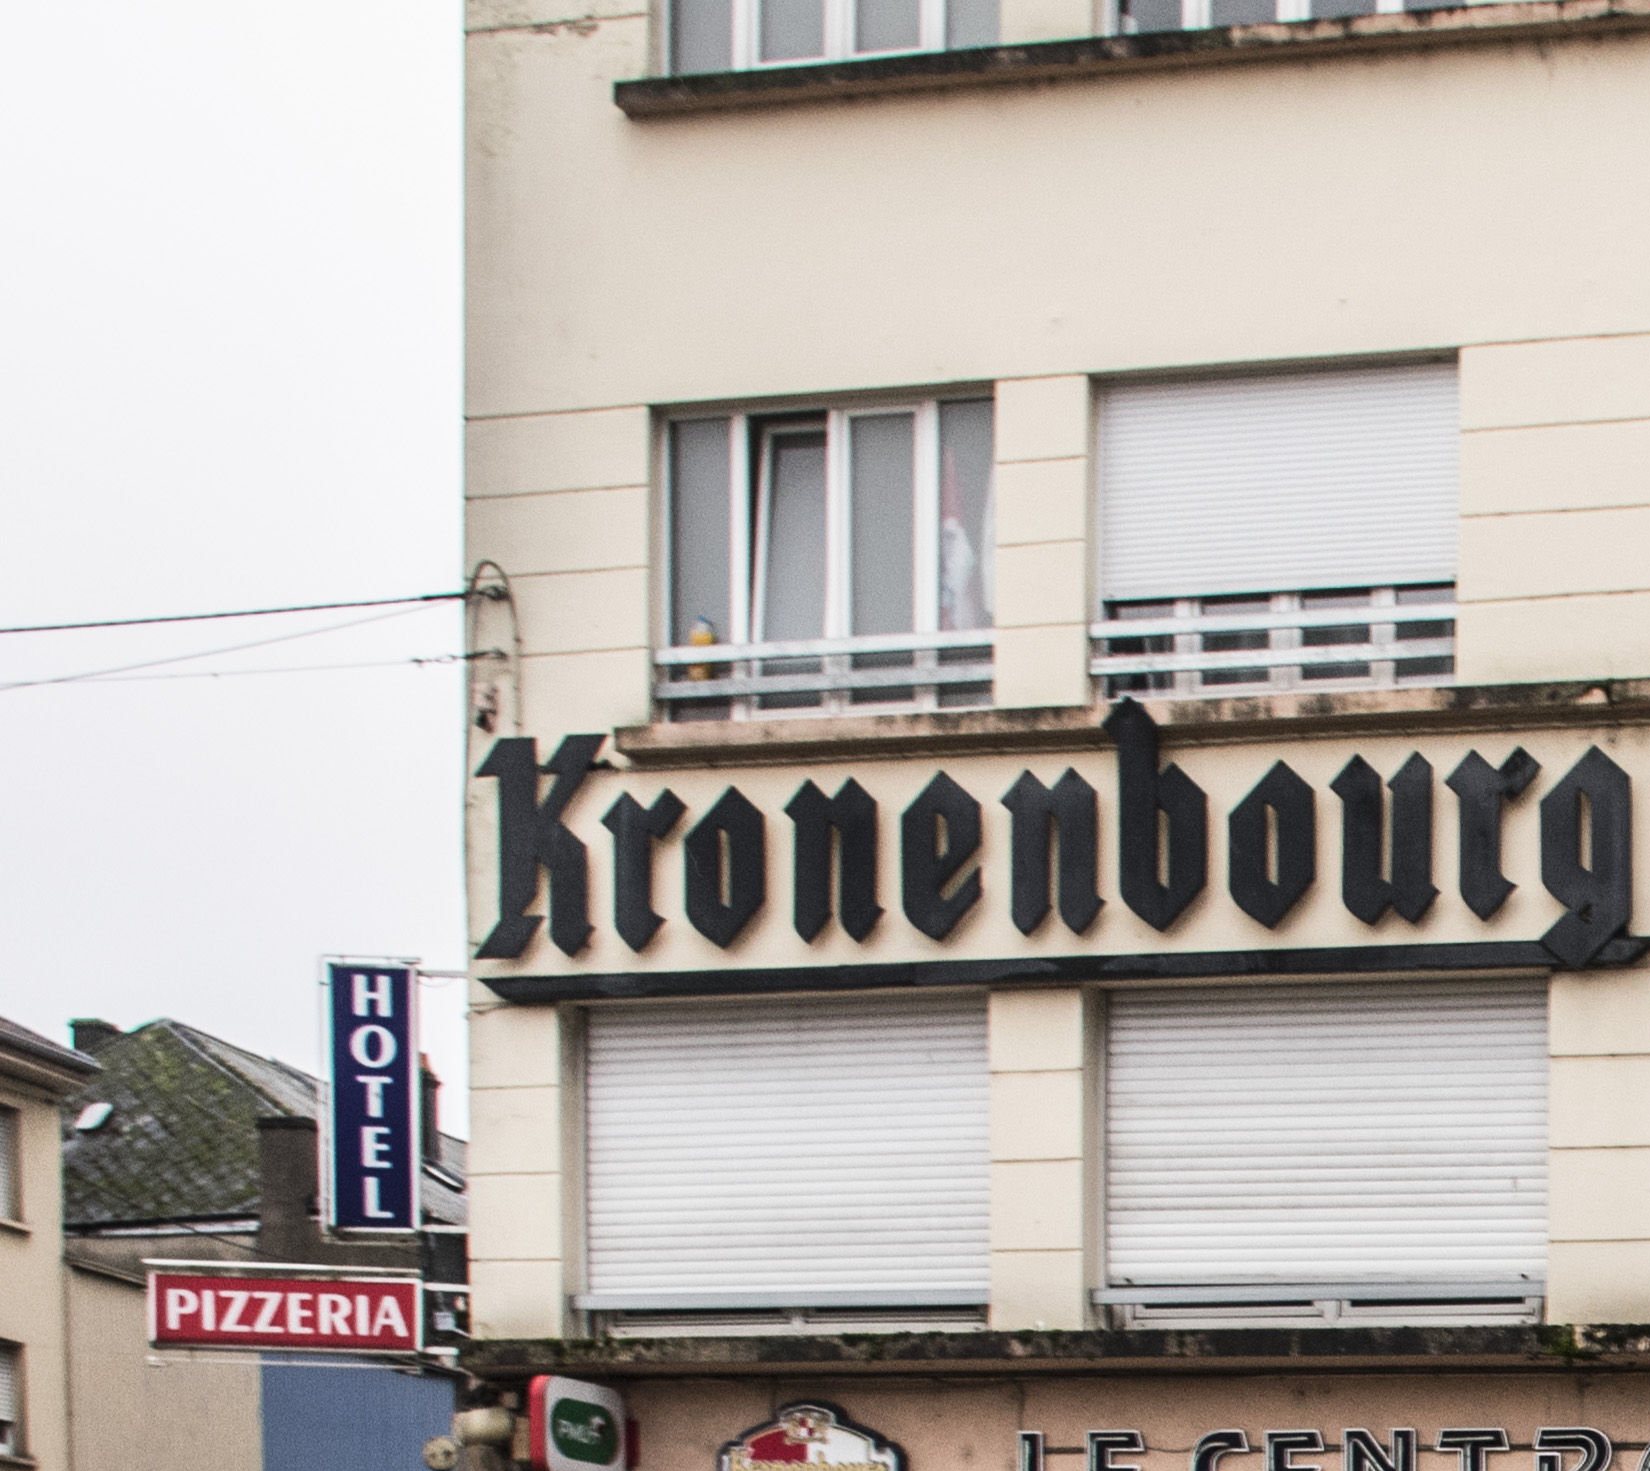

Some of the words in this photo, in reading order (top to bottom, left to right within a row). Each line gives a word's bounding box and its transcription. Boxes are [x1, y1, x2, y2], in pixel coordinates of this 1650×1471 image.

[475, 699, 1634, 970] Kronenbourg
[349, 973, 397, 1219] HOTEL
[164, 1288, 409, 1338] PIZZERIA
